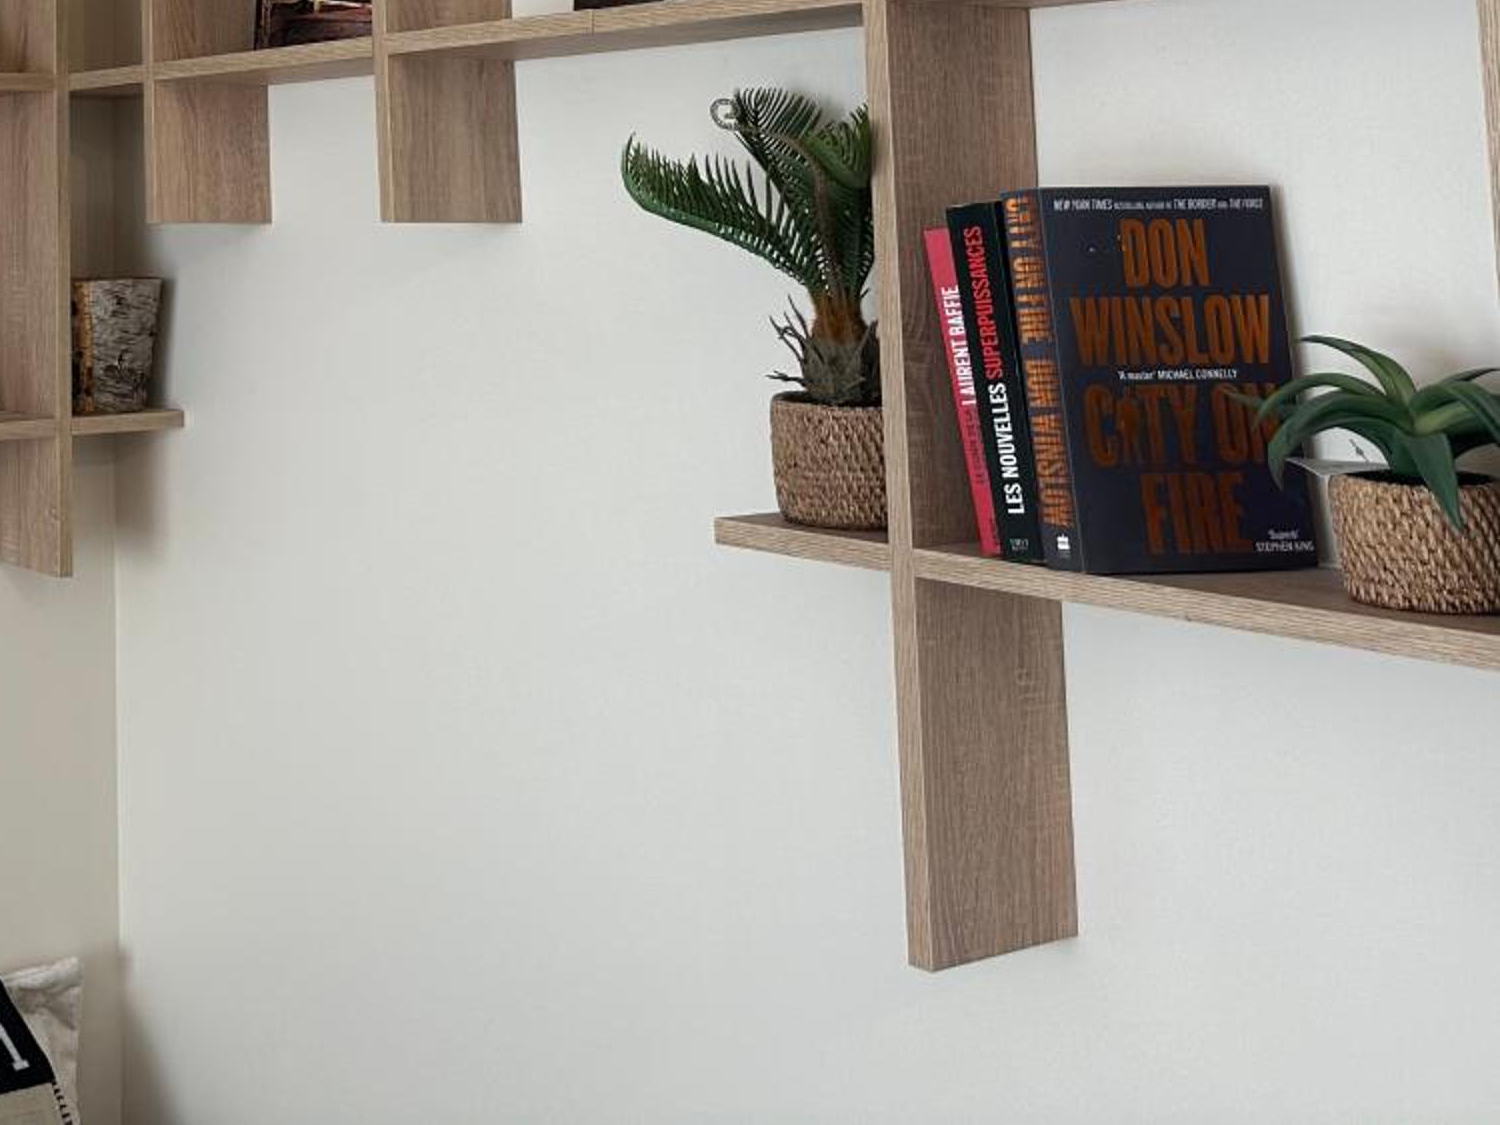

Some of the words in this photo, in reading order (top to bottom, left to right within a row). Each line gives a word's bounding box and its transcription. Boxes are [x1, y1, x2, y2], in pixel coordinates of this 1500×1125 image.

[1004, 196, 1042, 249] CITY
[1053, 198, 1071, 211] NEW
[1071, 198, 1091, 210] YORK
[1091, 198, 1113, 210] TIMES
[1173, 198, 1188, 210] THE
[1188, 198, 1217, 210] BORDER
[1229, 198, 1241, 210] THE
[1013, 256, 1045, 289] ON
[1119, 218, 1211, 288] DON
[941, 285, 967, 337] BAFFIE
[963, 226, 1004, 380] SUPERPUISSANCES
[1016, 293, 1053, 346] FIRE
[1069, 293, 1269, 364] WINSLOW
[952, 339, 977, 406] LAURENT
[1025, 358, 1061, 408] DON
[1157, 369, 1195, 380] MICHAEL
[1196, 368, 1237, 379] CONNELLY
[987, 382, 1020, 479] NOUVELLES
[1085, 382, 1197, 468] CITY
[1004, 483, 1025, 514] LES
[1030, 413, 1074, 531] WINSLOW
[1140, 472, 1253, 555] FIRE
[1255, 542, 1293, 553] STEPHEN
[1293, 540, 1314, 552] KING
